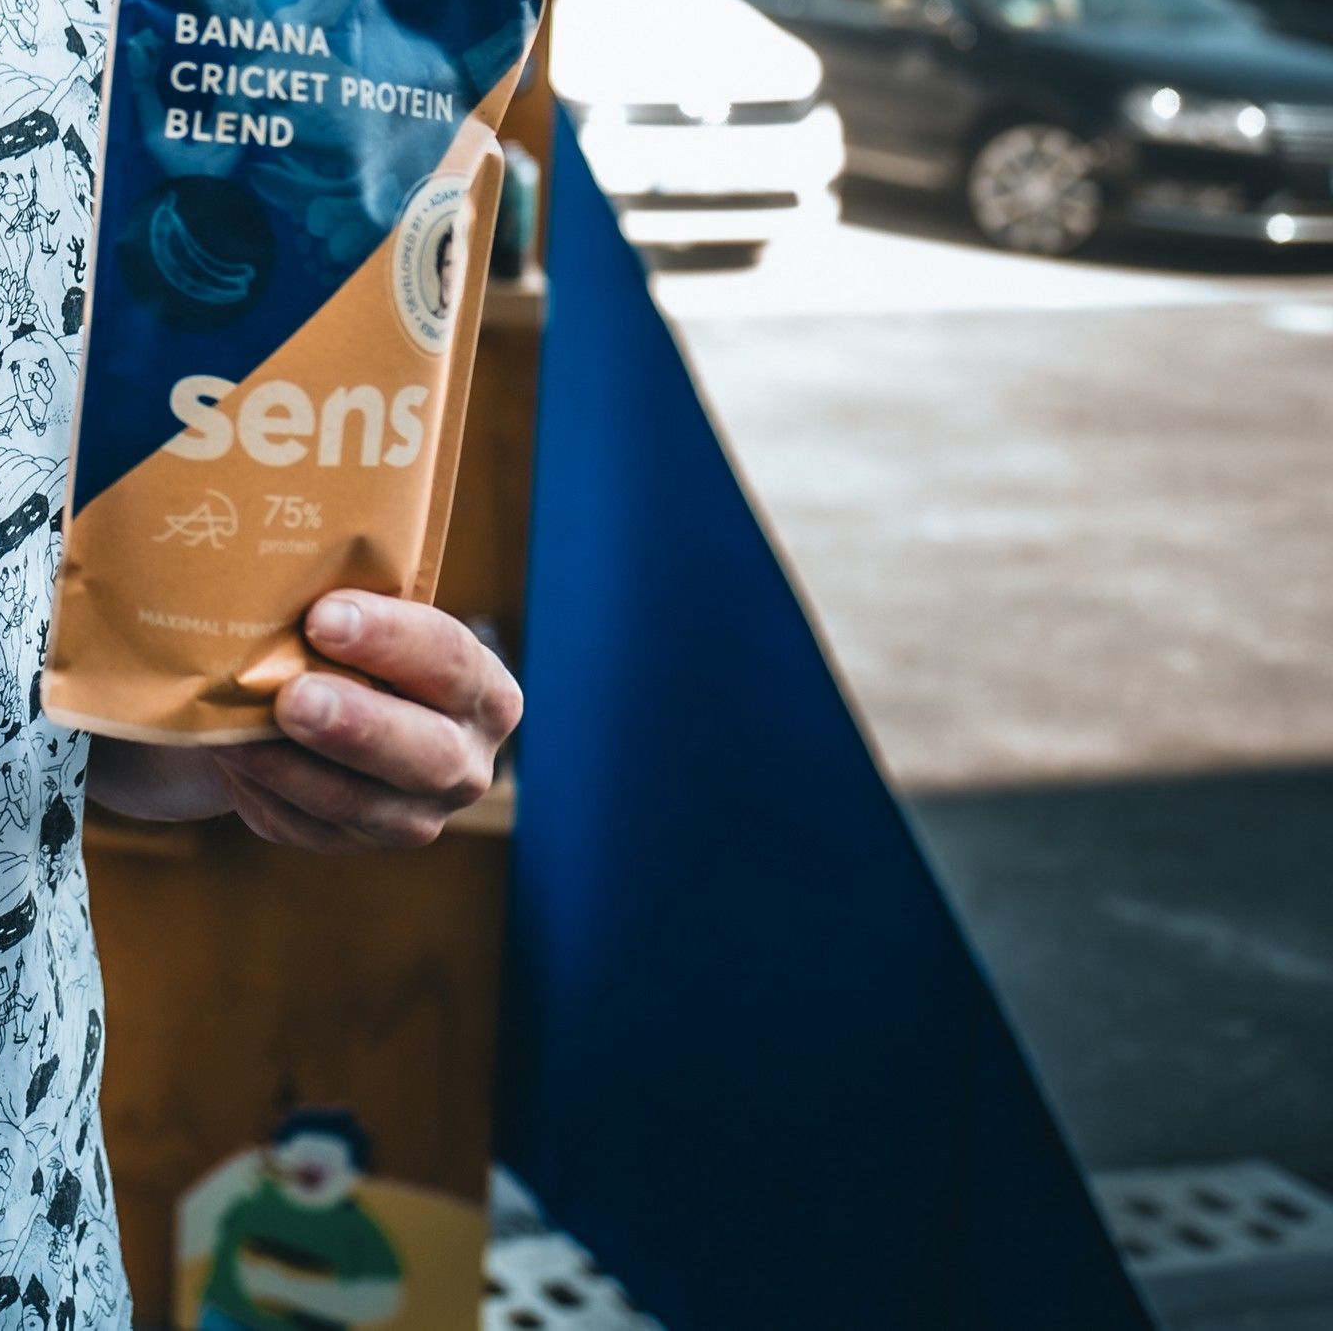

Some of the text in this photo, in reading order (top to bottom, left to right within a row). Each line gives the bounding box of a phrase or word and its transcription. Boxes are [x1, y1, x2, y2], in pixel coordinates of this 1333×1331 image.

[174, 12, 332, 58] BANANA
[169, 60, 454, 123] CRICKET PROTEIN
[163, 107, 295, 148] BLEND
[161, 374, 430, 469] sens
[262, 494, 323, 530] 75%
[258, 538, 321, 557] protein
[137, 608, 221, 636] MAXIMAL
